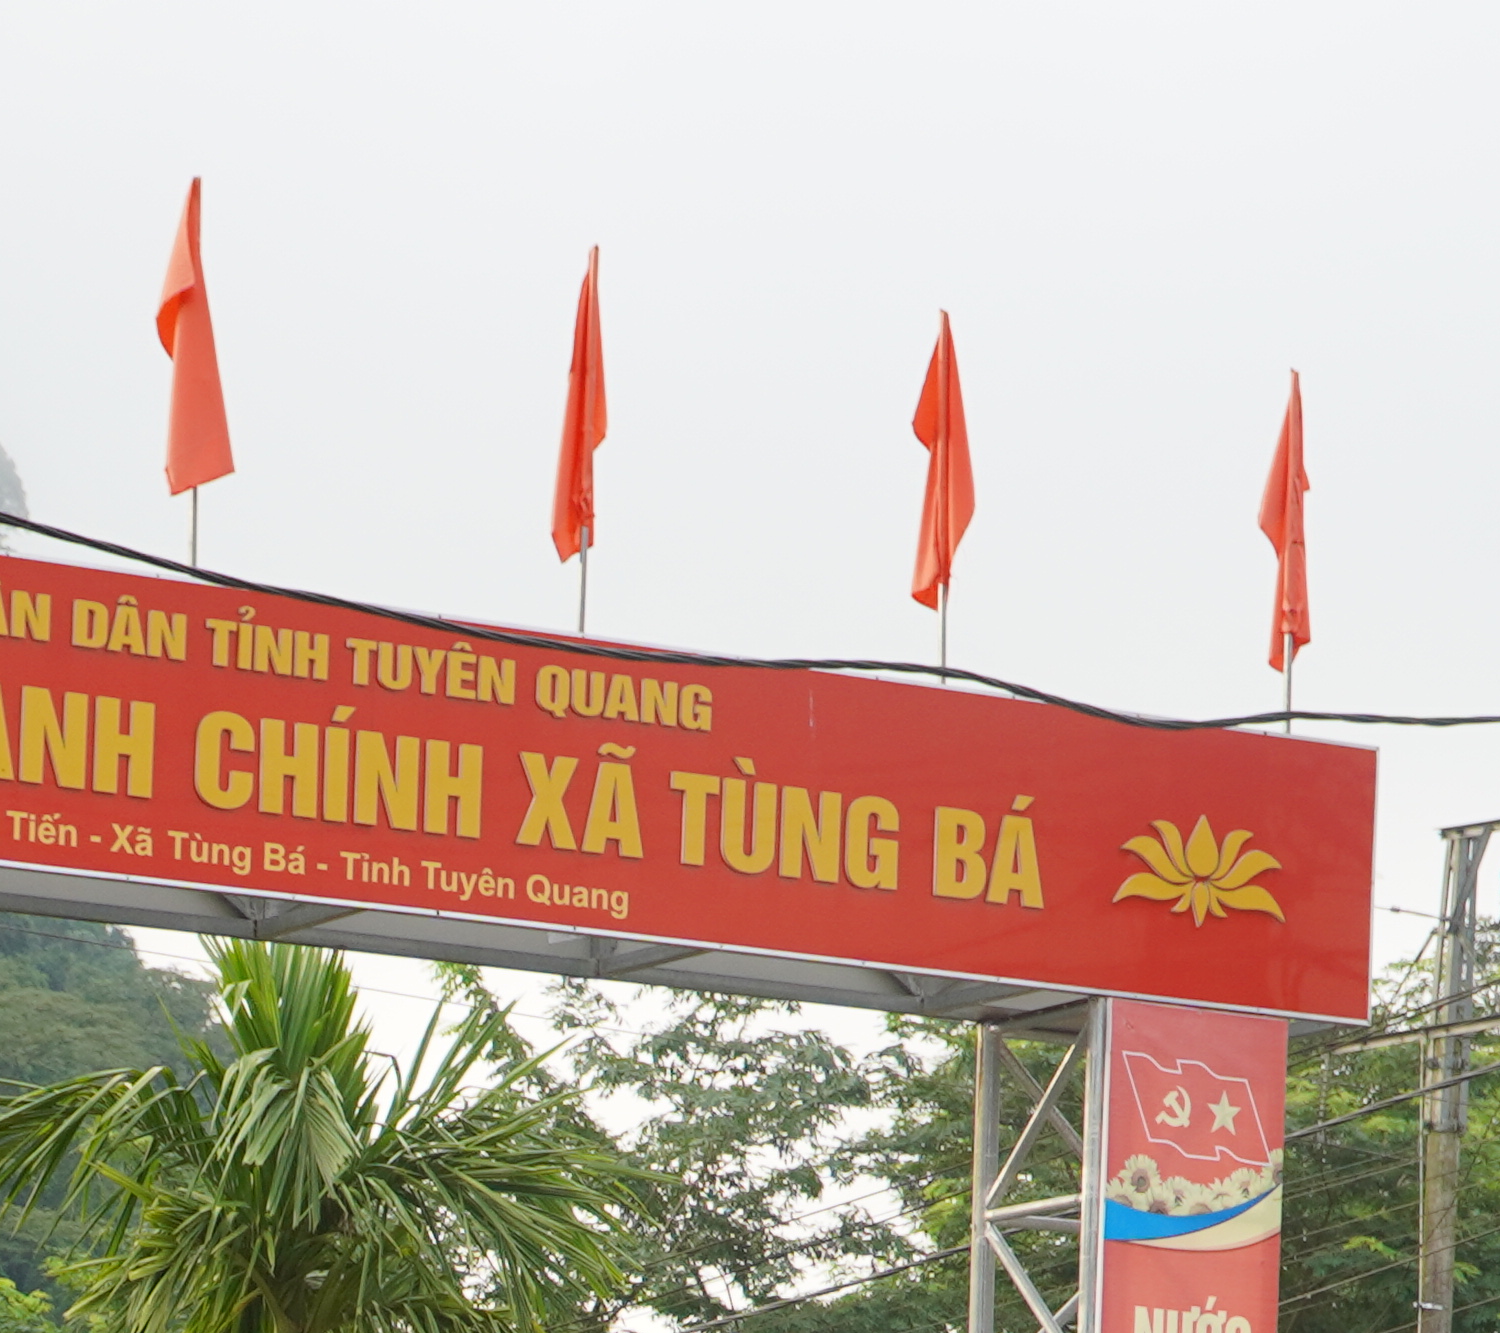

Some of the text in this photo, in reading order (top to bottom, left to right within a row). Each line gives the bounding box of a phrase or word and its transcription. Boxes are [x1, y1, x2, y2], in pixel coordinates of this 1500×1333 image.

[73, 594, 189, 662] DÂN
[207, 605, 332, 682] TỈNH
[349, 638, 518, 707] TUYÊN
[537, 664, 715, 733] QUANG
[6, 810, 79, 849] Tiến
[110, 823, 155, 858] Xã
[168, 830, 253, 877] Tùng
[263, 842, 307, 876] Bá
[339, 850, 412, 888] Tỉnh
[421, 859, 517, 903] Tuyên
[526, 874, 631, 921] Quang
[195, 705, 485, 840] CHÍNH
[518, 742, 646, 860] XÃ
[671, 756, 902, 891] TÙNG
[935, 794, 1046, 910] BÁ
